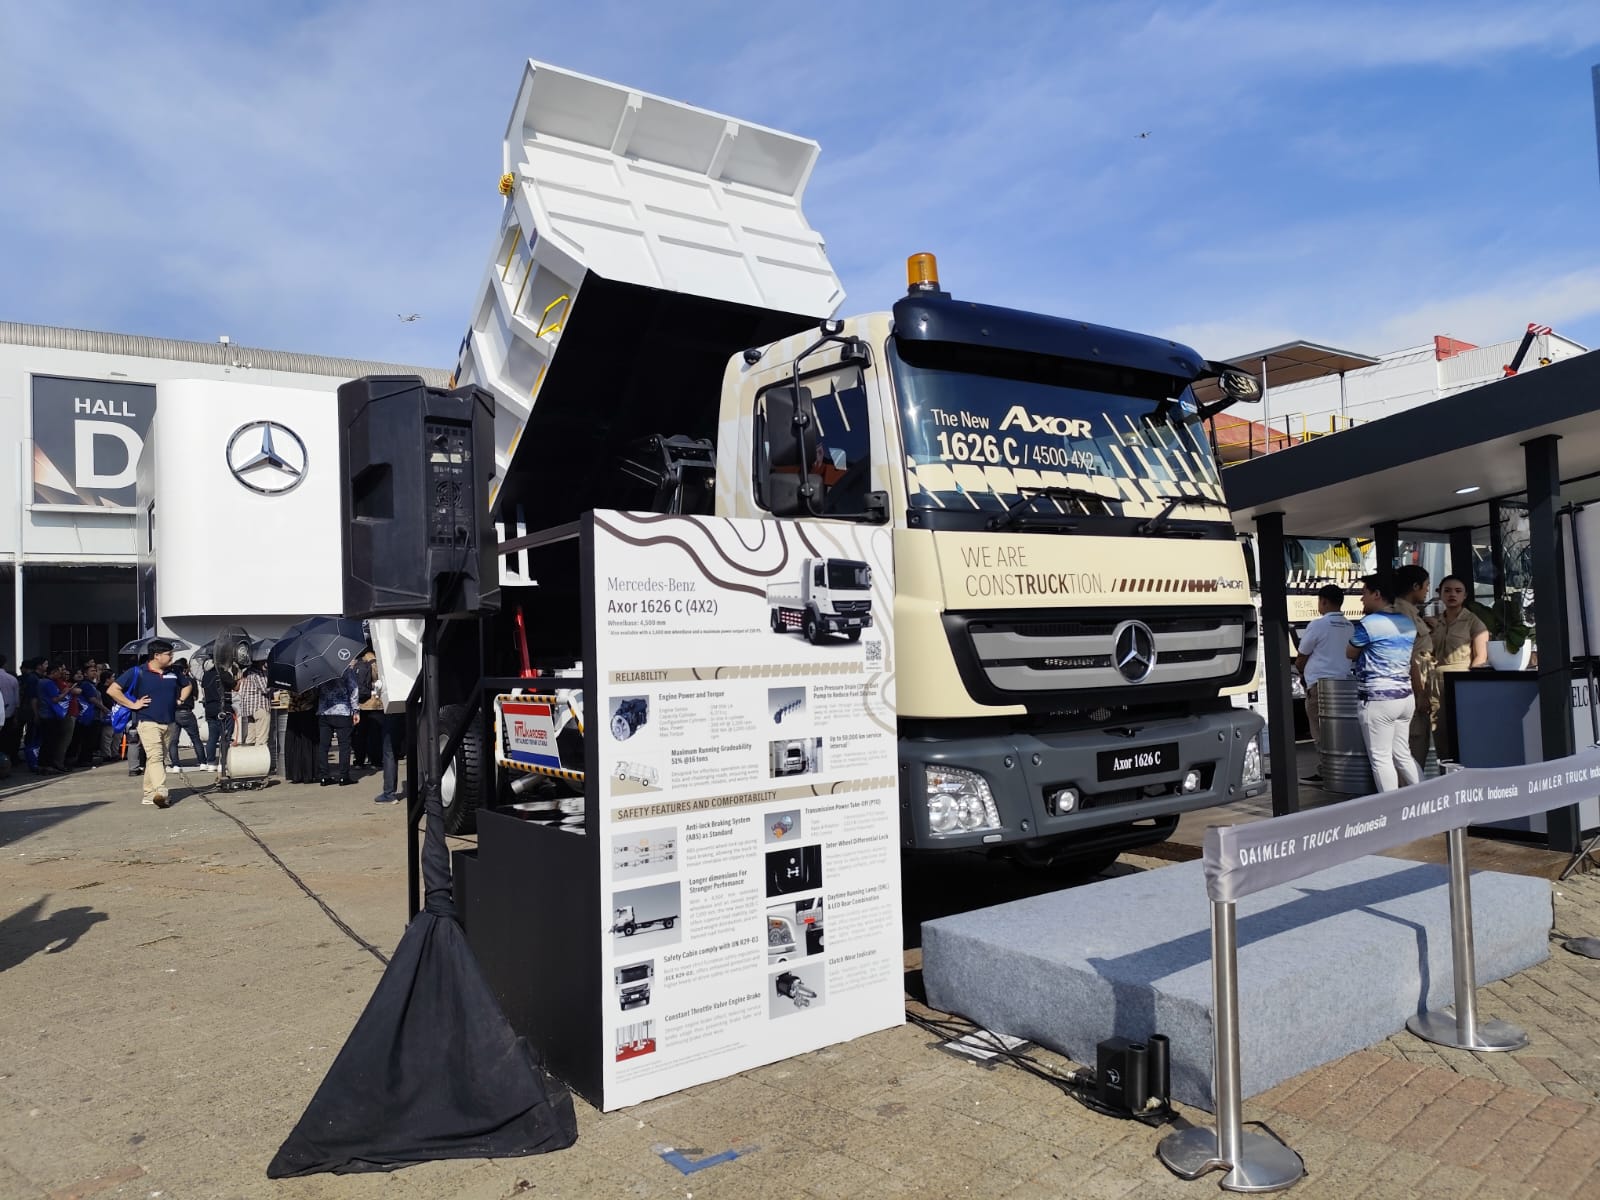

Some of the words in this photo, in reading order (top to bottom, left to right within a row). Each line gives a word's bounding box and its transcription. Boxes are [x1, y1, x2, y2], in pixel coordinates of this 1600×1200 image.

[74, 397, 136, 417] HALL
[930, 408, 958, 426] The
[961, 411, 989, 429] New
[74, 419, 144, 489] D
[937, 431, 1000, 464] 1626
[1003, 437, 1020, 466] C
[1032, 445, 1068, 468] 4500
[961, 546, 992, 568] WE
[997, 546, 1028, 567] ARE
[608, 577, 696, 592] Mercedes-Benz
[966, 573, 1106, 597] CONSTRUCKTION.
[608, 600, 638, 613] Axor
[641, 600, 671, 613] 1626
[675, 600, 683, 613] C
[686, 599, 718, 616] (4X2)
[615, 671, 668, 682] RELIABILITY
[659, 693, 677, 701] Engine
[678, 692, 695, 700] Power
[707, 691, 725, 699] Torque
[672, 749, 698, 757] Maximum
[699, 747, 720, 755] Running
[720, 744, 752, 752] Gradeability
[672, 757, 683, 765] 51%
[1113, 757, 1133, 771] Axor
[1134, 752, 1154, 768] 1626
[1154, 751, 1161, 765] C
[1528, 774, 1562, 794] DAIMLER
[1565, 768, 1588, 784] TRUCK
[617, 807, 650, 820] SAFETY
[651, 801, 691, 815] FEATURES
[693, 799, 710, 809] AND
[711, 791, 777, 808] COMFORTABILITY
[805, 805, 835, 814] Transmission
[1401, 794, 1450, 820] DAIMLER
[1454, 787, 1484, 805] TRUCK
[1487, 784, 1519, 801] Indonesia
[685, 822, 710, 831] Anti-lock
[711, 819, 732, 829] Braking
[732, 816, 751, 825] System
[685, 832, 702, 842] (ABS)
[709, 828, 733, 838] Standard
[1239, 839, 1296, 866] DAIMLER
[1302, 826, 1340, 851] TRUCK
[1344, 814, 1388, 839] Indonesia
[689, 876, 708, 886] Longer
[708, 871, 738, 882] dimensions
[690, 884, 712, 894] Stronger
[663, 953, 682, 963] Safety
[682, 950, 698, 960] Cabin
[698, 945, 719, 956] comply
[664, 1010, 690, 1022] Constant
[691, 1004, 713, 1015] Throttle
[713, 1001, 728, 1010] Valve
[728, 996, 746, 1007] Engine
[746, 992, 761, 1001] Brake
